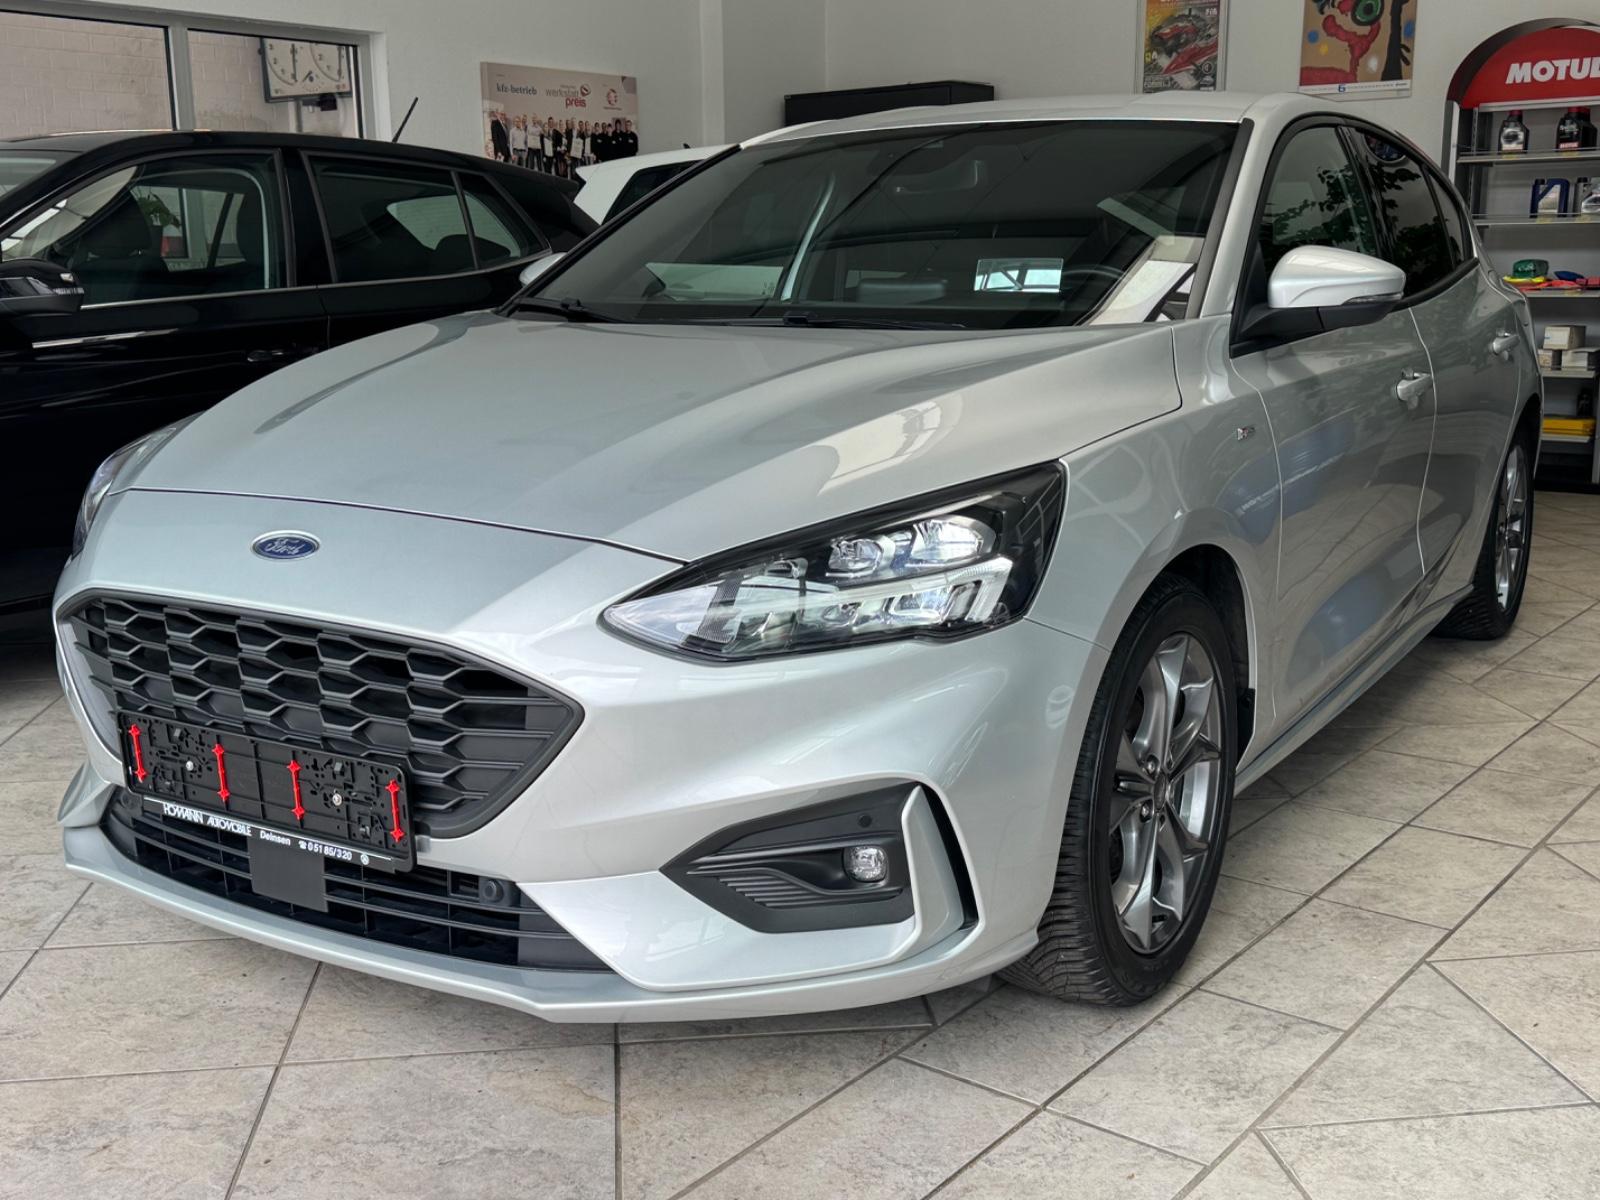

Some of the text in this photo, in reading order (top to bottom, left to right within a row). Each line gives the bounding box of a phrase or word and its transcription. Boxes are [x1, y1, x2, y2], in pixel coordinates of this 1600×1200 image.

[496, 83, 537, 96] kfz-betrieb
[565, 97, 587, 109] preis
[263, 538, 306, 555] Ford
[206, 815, 252, 837] AUTOMOBILE
